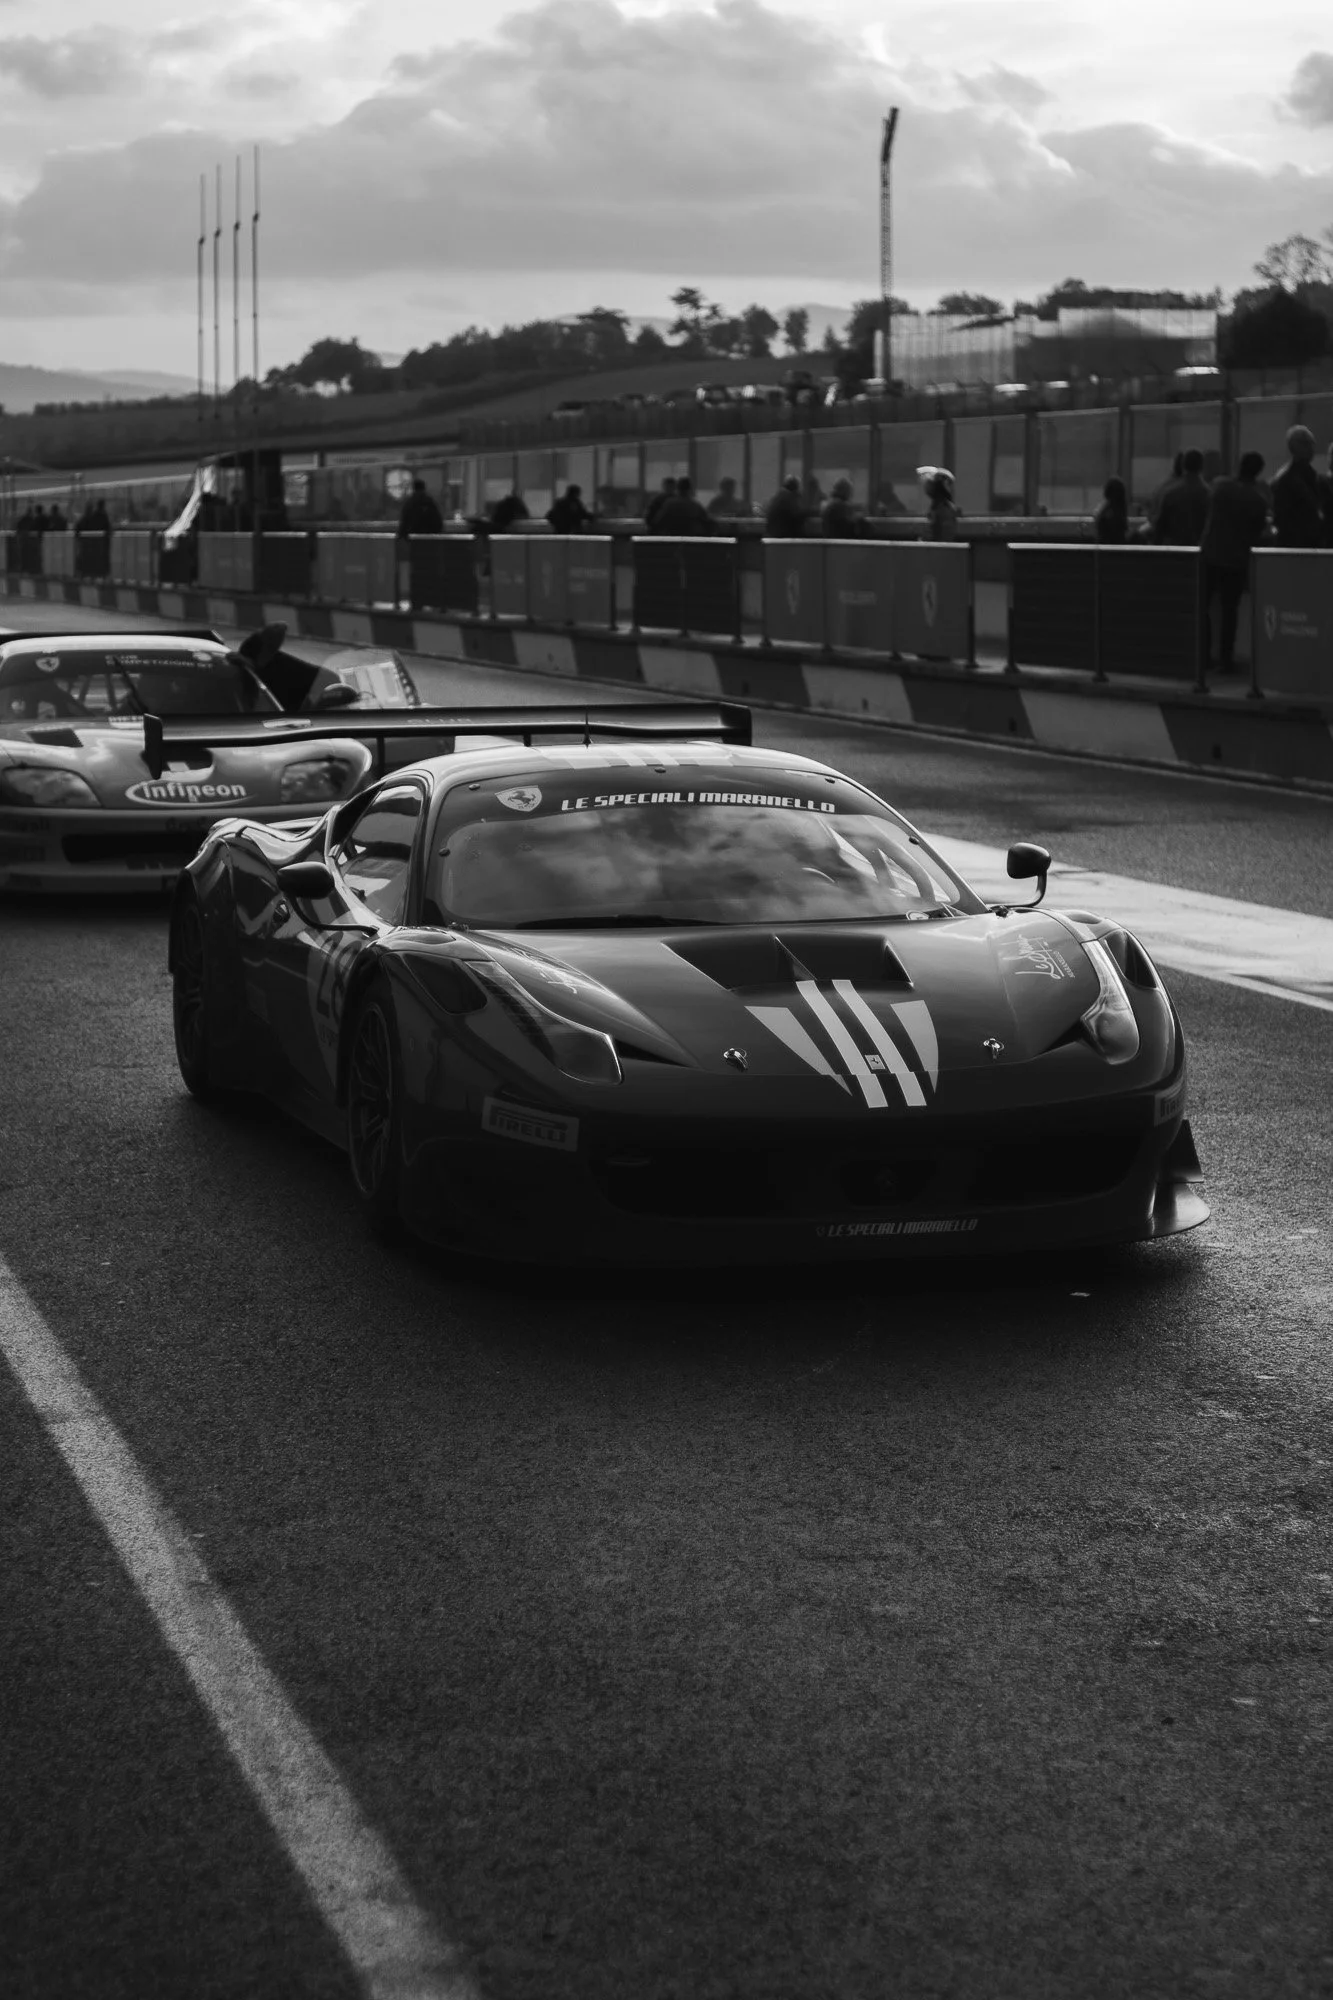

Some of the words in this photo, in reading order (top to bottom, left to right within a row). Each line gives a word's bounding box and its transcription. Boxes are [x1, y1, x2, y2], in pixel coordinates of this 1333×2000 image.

[561, 797, 589, 811] LE
[594, 792, 695, 807] SPECIALI
[699, 792, 836, 813] MARANELLO
[490, 1104, 569, 1143] PIRELLI
[828, 1225, 846, 1237] LE
[846, 1222, 902, 1236] SPECIALI
[902, 1219, 979, 1235] MARANELLO
